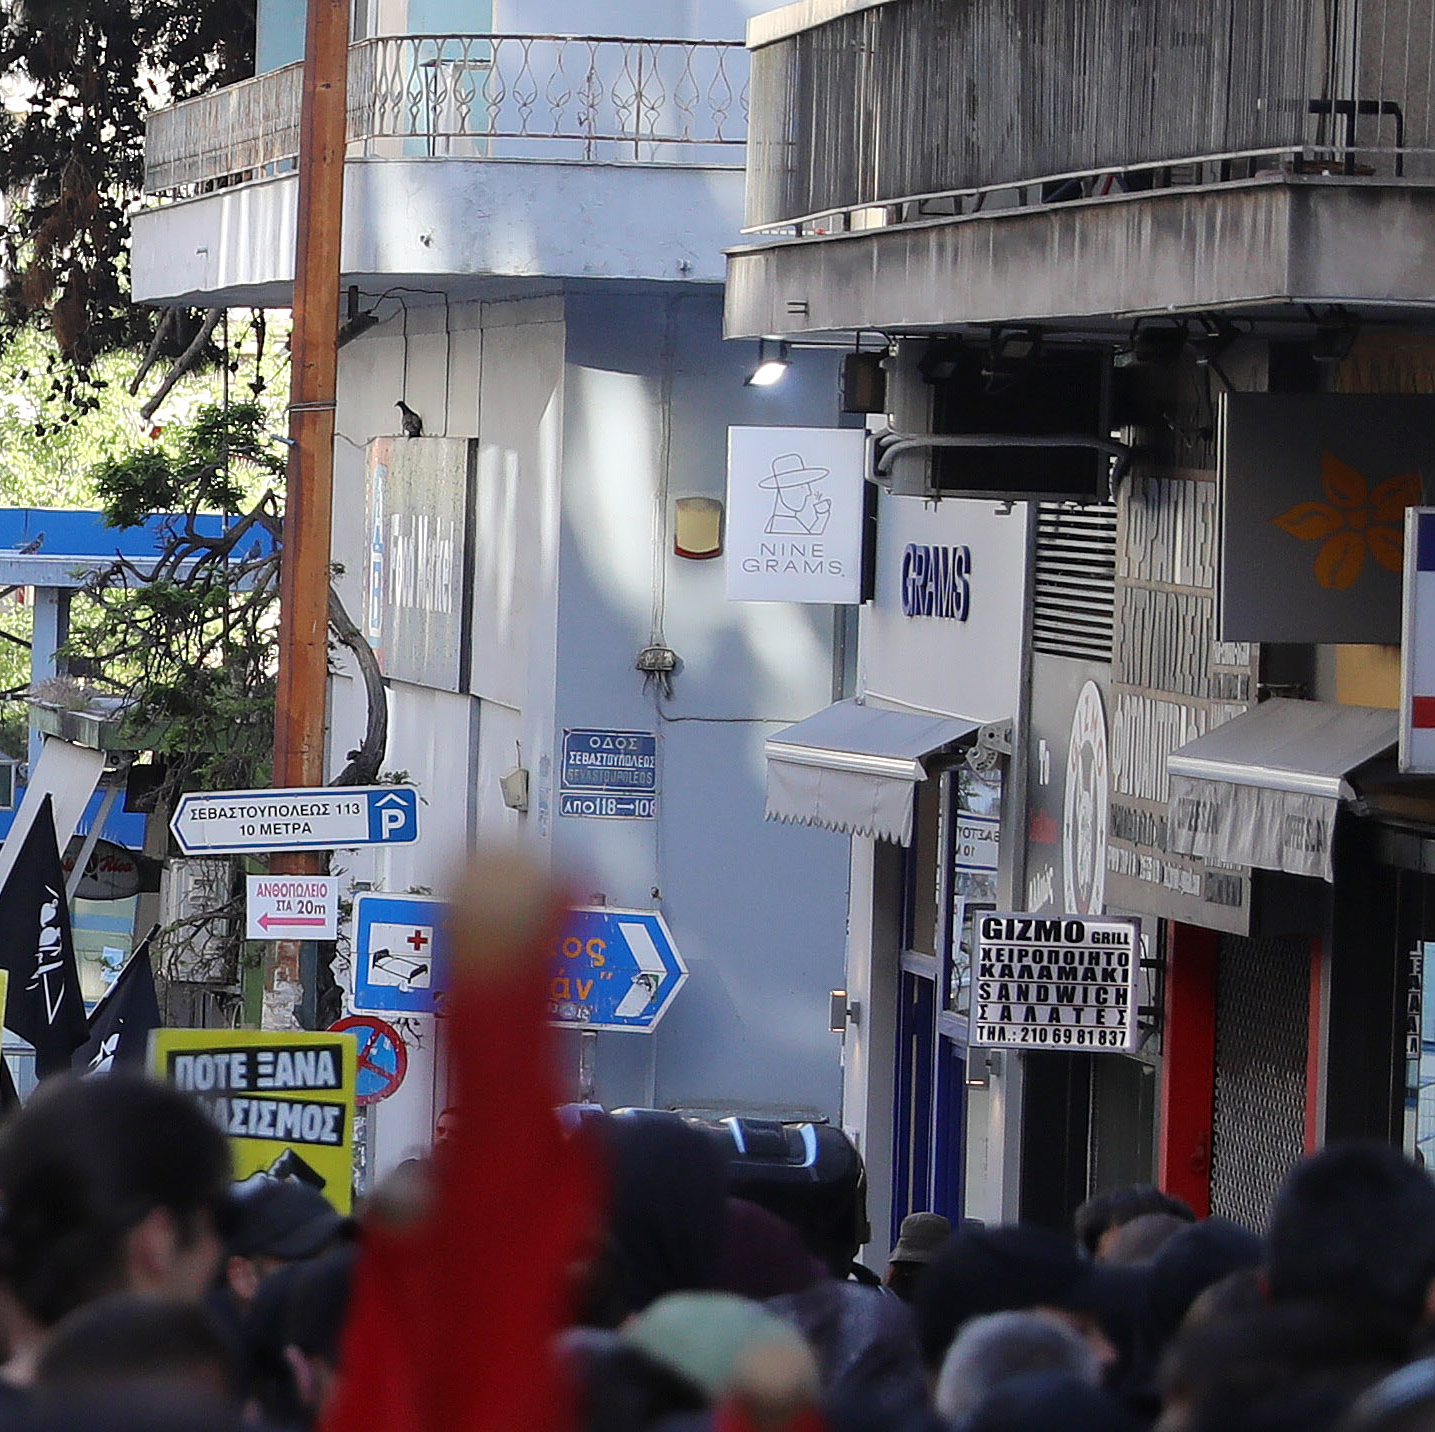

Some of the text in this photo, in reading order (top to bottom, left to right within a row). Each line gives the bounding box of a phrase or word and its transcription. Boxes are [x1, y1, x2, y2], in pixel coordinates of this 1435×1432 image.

[760, 542, 825, 558] NINE
[901, 541, 972, 623] GRAMS
[589, 736, 638, 750] ΟΔΟΣ
[190, 803, 361, 821] ΣΕΒΑΣΤΟΥΠΟΛΕΩΣ 113
[564, 799, 595, 813] ΑΠΟ
[595, 797, 617, 815] 118
[239, 822, 312, 836] 10 ΜΕΤΡΑ
[382, 808, 406, 840] P
[256, 883, 328, 898] ΑΝΘΟΠΩΛΕΙΟ
[276, 901, 326, 915] ΣΤΑ 20m
[982, 918, 1130, 945] GIZMO GRILL
[981, 947, 1130, 967] ΧΕΙΡΟΠΟΙΗΤΟ
[980, 963, 1129, 983] ΚΑΛΑΜΑΚΙ
[978, 982, 1128, 1006] SANDWICH
[978, 1004, 1127, 1026] ΣΑΛΑΤΕΣ
[1020, 1026, 1048, 1043] 210
[1052, 1028, 1072, 1044] 69
[1076, 1029, 1094, 1045] 81
[1098, 1029, 1126, 1047] 837
[174, 1050, 338, 1091] ΠΟΤΕ ΞΑΝΑ
[198, 1096, 340, 1144] ΑΣΙΣΜΟΣ
